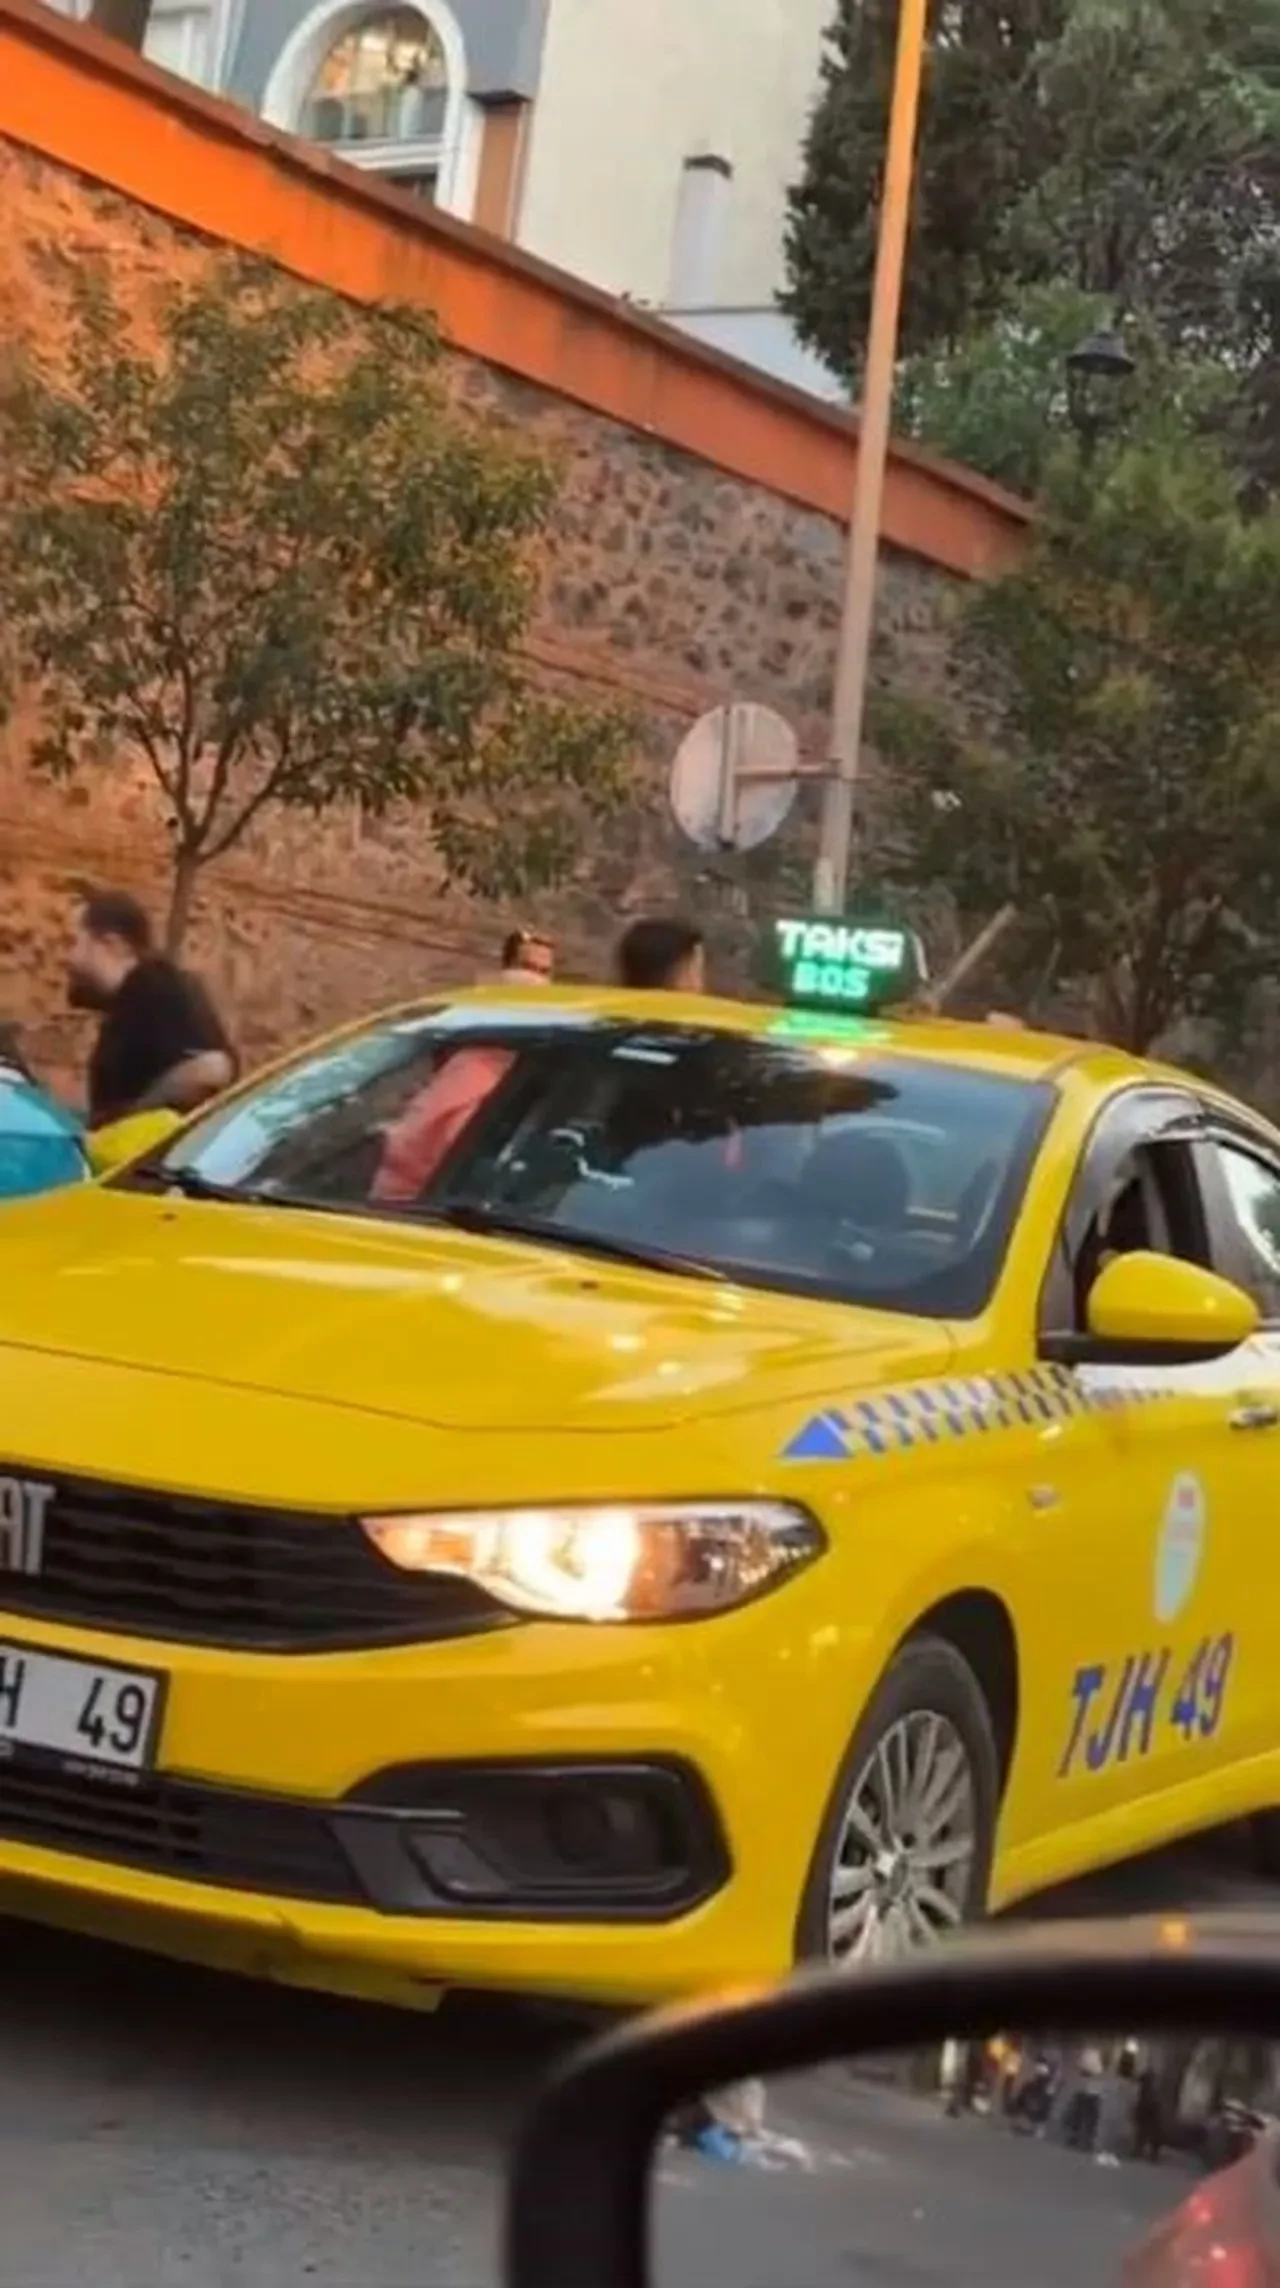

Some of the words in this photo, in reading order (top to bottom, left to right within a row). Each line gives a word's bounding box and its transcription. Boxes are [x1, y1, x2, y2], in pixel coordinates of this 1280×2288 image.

[77, 1676, 146, 1754] 49
[1057, 1646, 1171, 1779] TJH
[1170, 1629, 1234, 1740] 49
